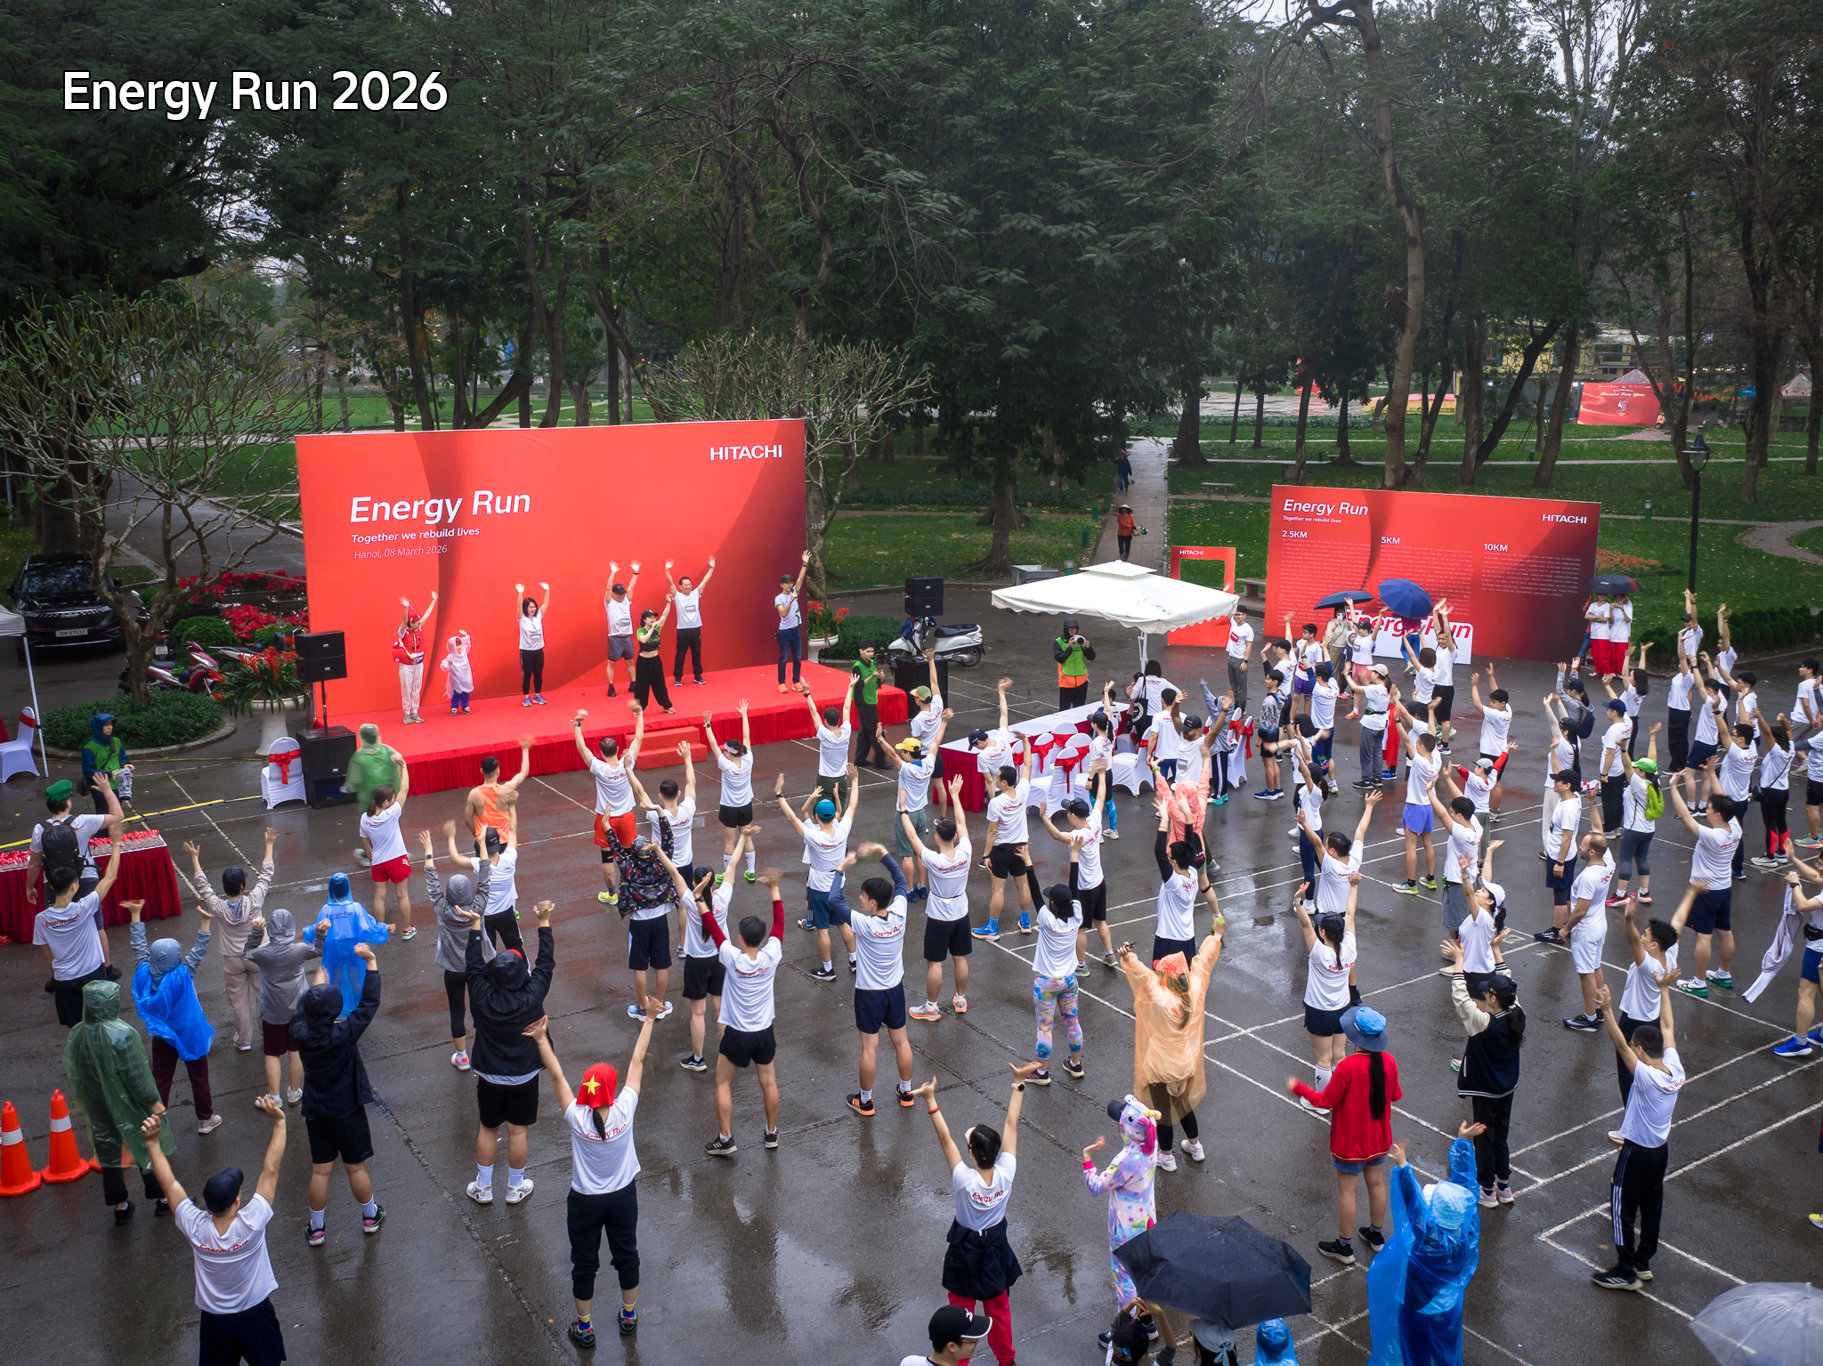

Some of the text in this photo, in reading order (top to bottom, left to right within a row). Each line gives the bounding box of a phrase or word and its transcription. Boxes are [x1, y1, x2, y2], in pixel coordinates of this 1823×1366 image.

[710, 444, 783, 461] HITACHI
[350, 490, 531, 525] Energy Run
[1283, 499, 1369, 516] Energy Run
[1542, 513, 1588, 525] HITACHI
[351, 533, 399, 545] Together
[419, 528, 455, 539] rebuild
[457, 527, 480, 537] lives
[1282, 530, 1308, 539] 2.5KM
[1381, 536, 1401, 545] 5KM
[354, 544, 448, 559] Hanoi, 08 March 2026
[1484, 543, 1508, 552] 10KM
